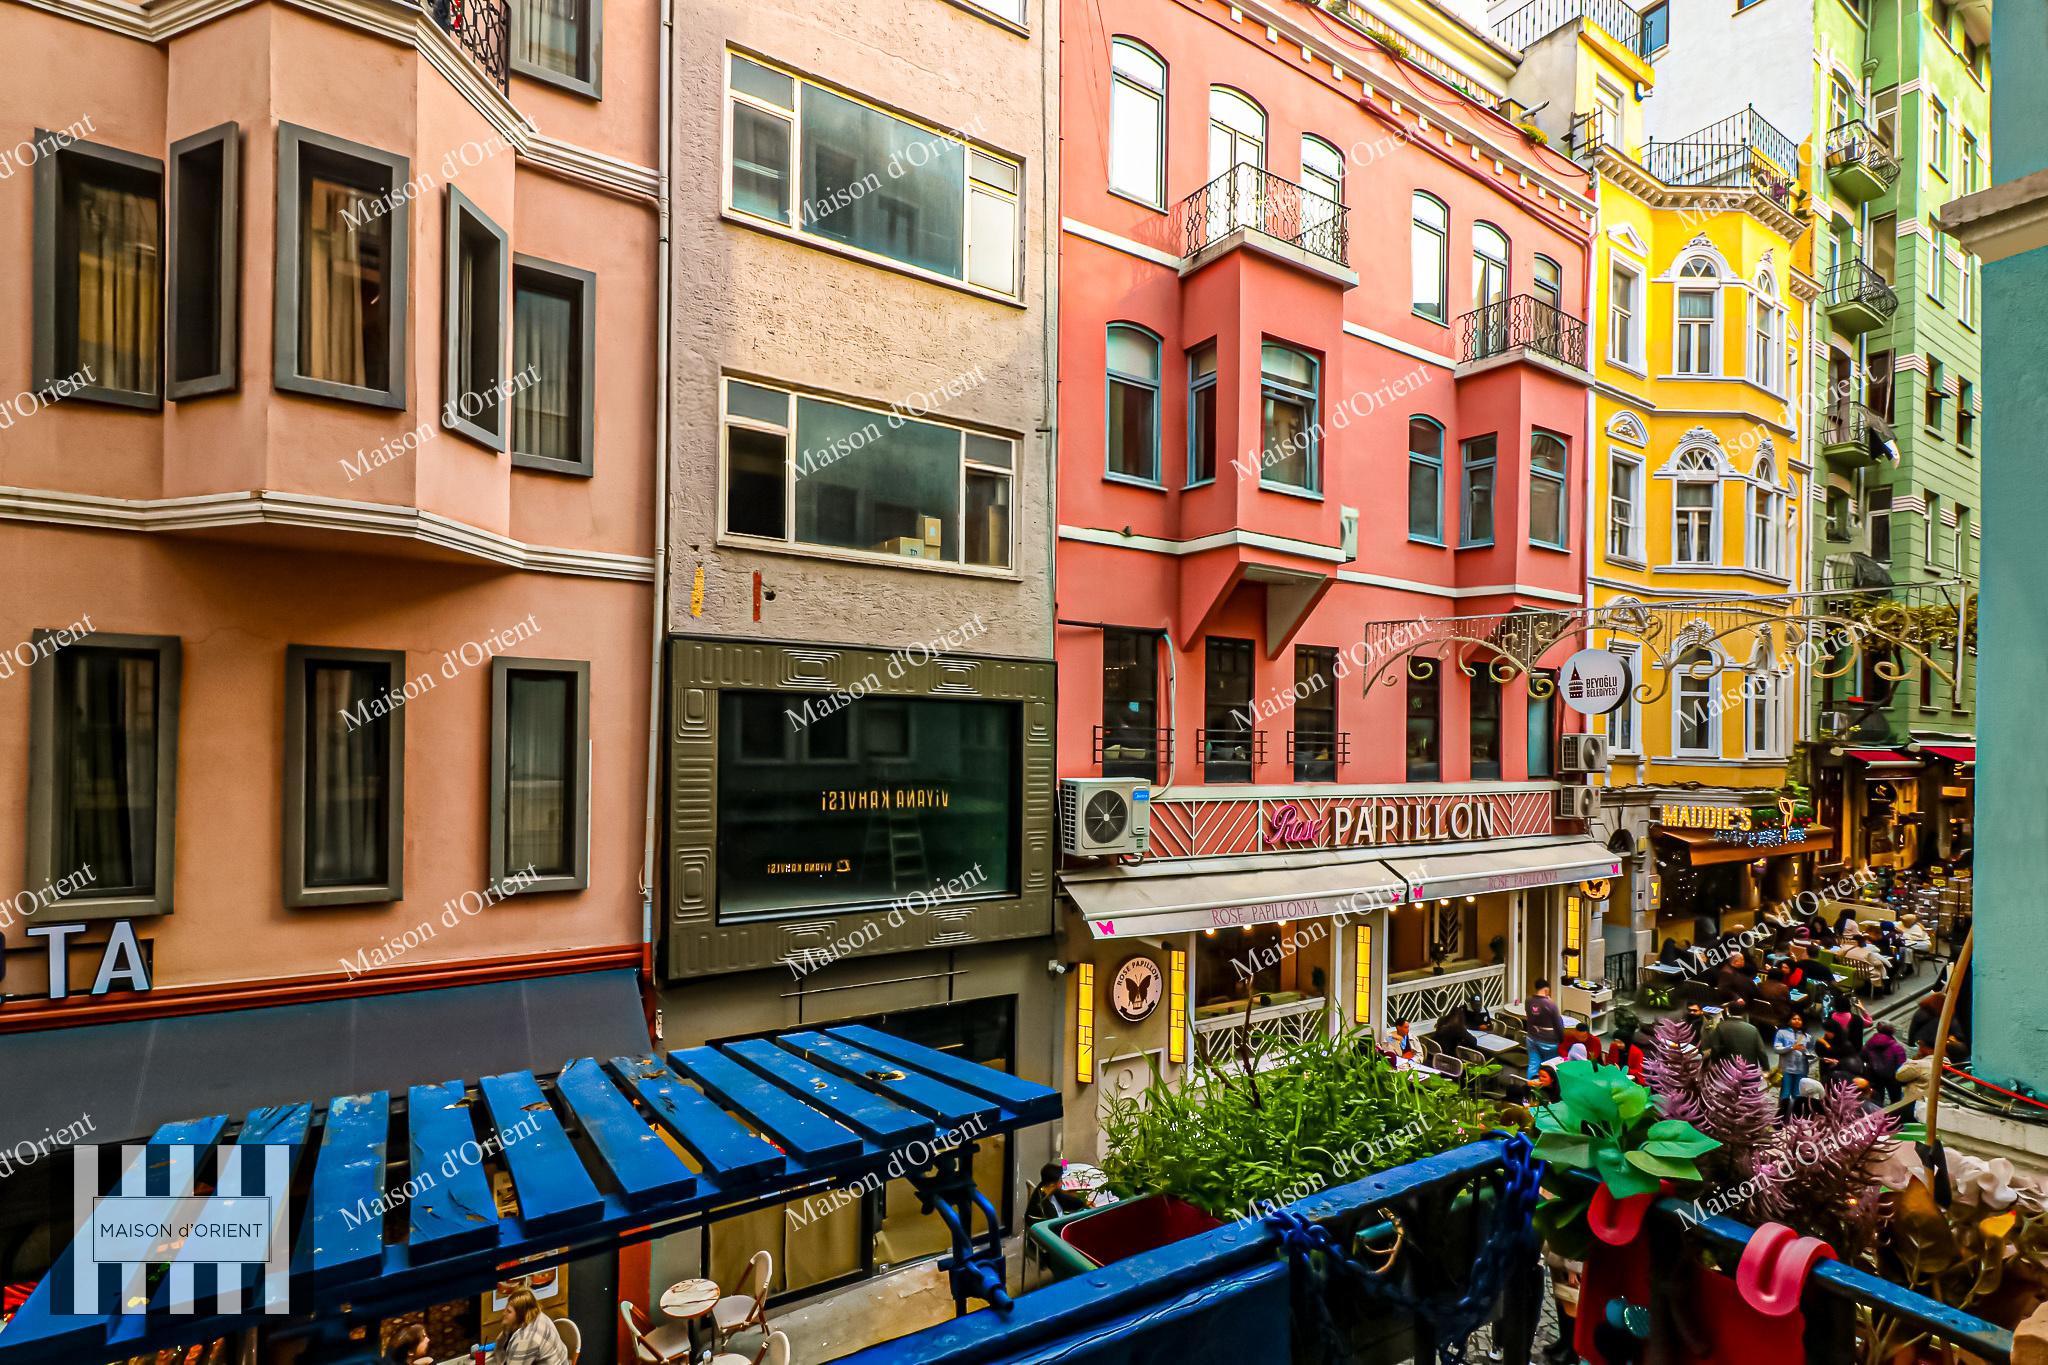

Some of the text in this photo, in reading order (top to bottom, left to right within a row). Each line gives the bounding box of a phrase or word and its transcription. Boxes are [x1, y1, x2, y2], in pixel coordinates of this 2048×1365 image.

[1586, 675, 1618, 688] BEYOĞLU
[1264, 802, 1494, 846] Rose PAPILLON
[1662, 804, 1752, 831] MADDIE'S
[1211, 900, 1320, 925] ROSE PAPILLONYA
[0, 921, 150, 999] TA
[1117, 960, 1159, 986] ROSE PAPILLON
